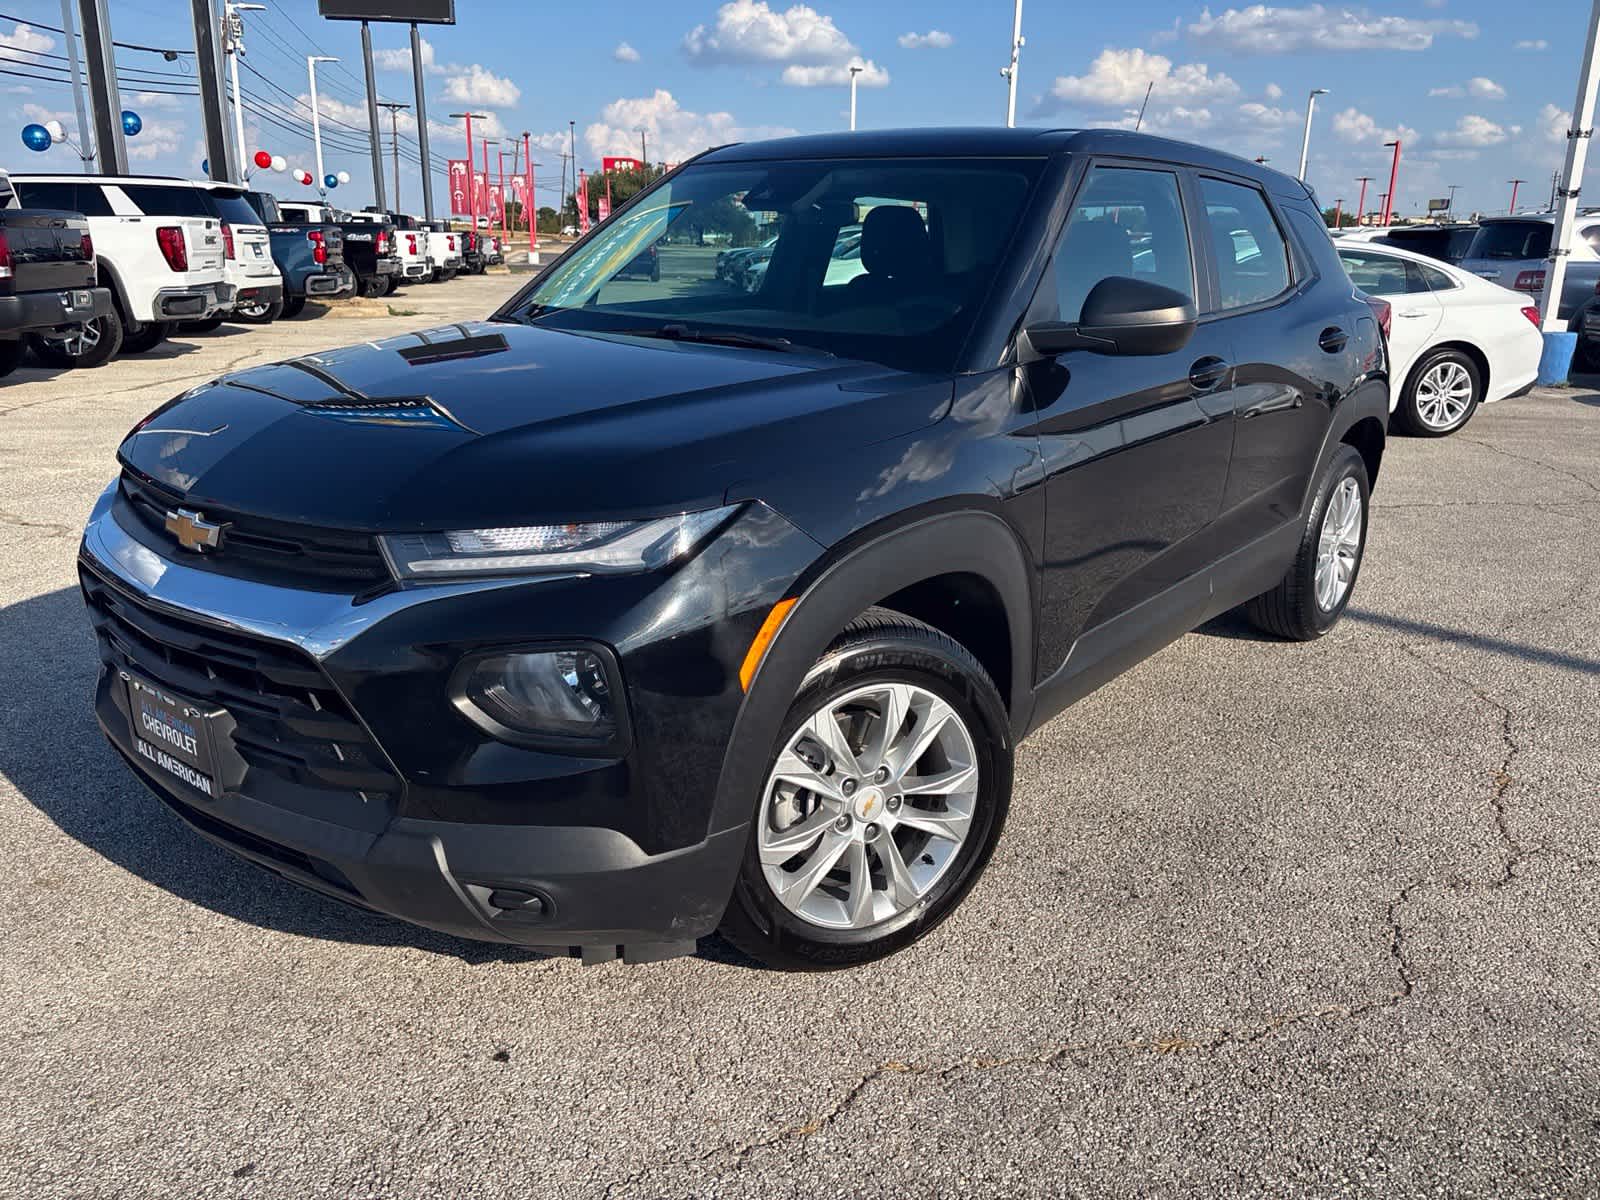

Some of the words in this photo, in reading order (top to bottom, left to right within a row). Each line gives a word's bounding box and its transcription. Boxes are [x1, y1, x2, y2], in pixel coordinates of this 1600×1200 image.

[142, 712, 198, 756] CHEVROLET
[138, 740, 157, 763] ALL
[157, 752, 212, 796] AMERICAN
